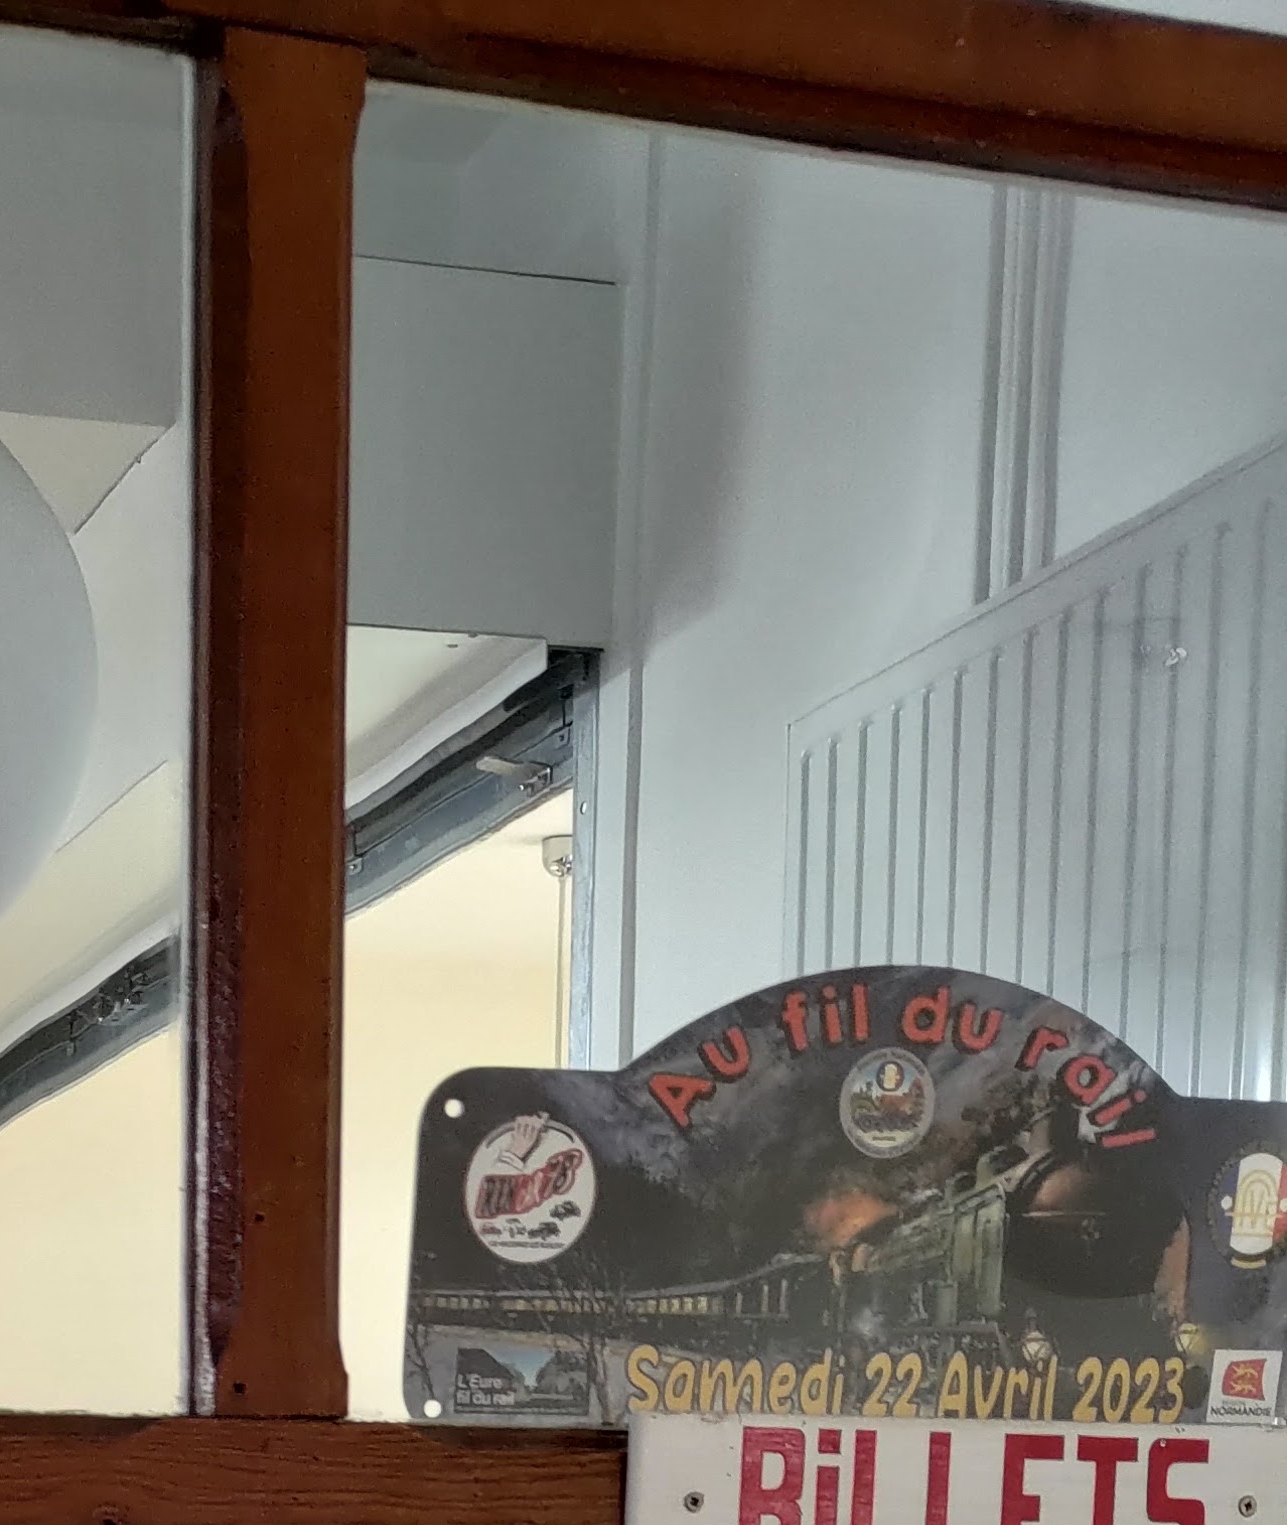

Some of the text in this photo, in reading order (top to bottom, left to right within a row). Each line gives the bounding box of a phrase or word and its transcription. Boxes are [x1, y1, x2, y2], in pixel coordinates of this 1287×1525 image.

[649, 985, 1155, 1148] Au fil du rail
[628, 1345, 1185, 1423] Samedi 22 Avril 2023
